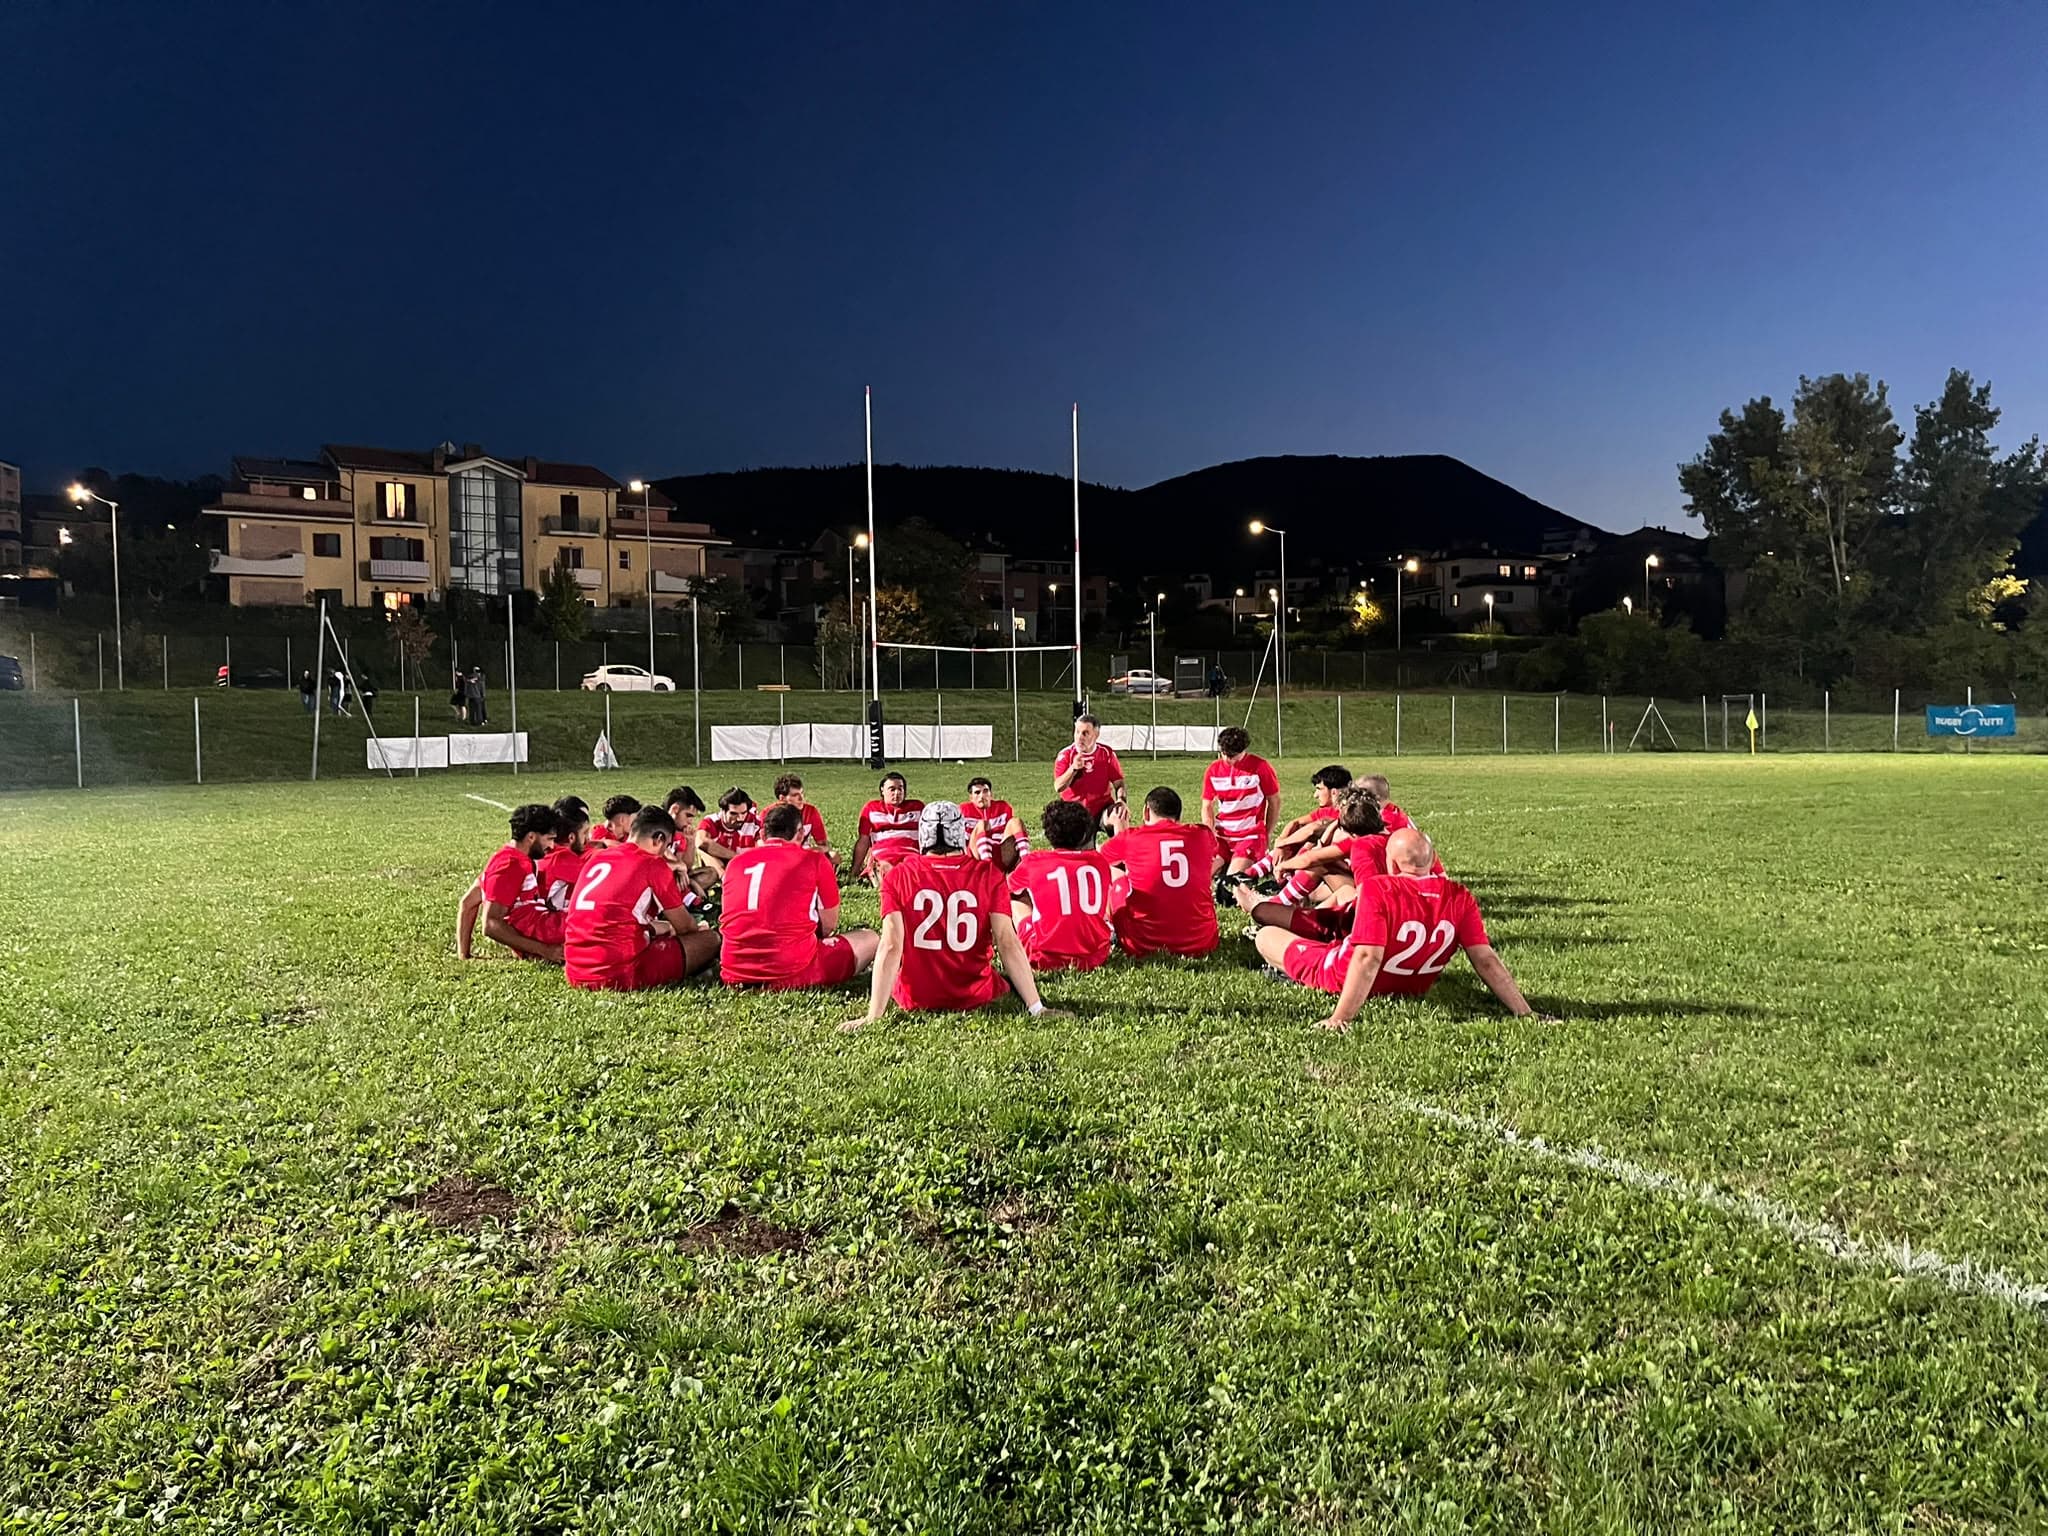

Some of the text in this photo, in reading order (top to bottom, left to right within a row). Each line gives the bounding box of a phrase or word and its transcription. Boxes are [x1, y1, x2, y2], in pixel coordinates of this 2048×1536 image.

[1935, 717, 2004, 726] RUGBY TUTTI
[575, 862, 612, 911] 2
[743, 861, 766, 911] 1
[1160, 840, 1189, 888] 5
[1046, 864, 1102, 916] 10
[913, 888, 978, 952] 26
[1382, 919, 1455, 976] 22
